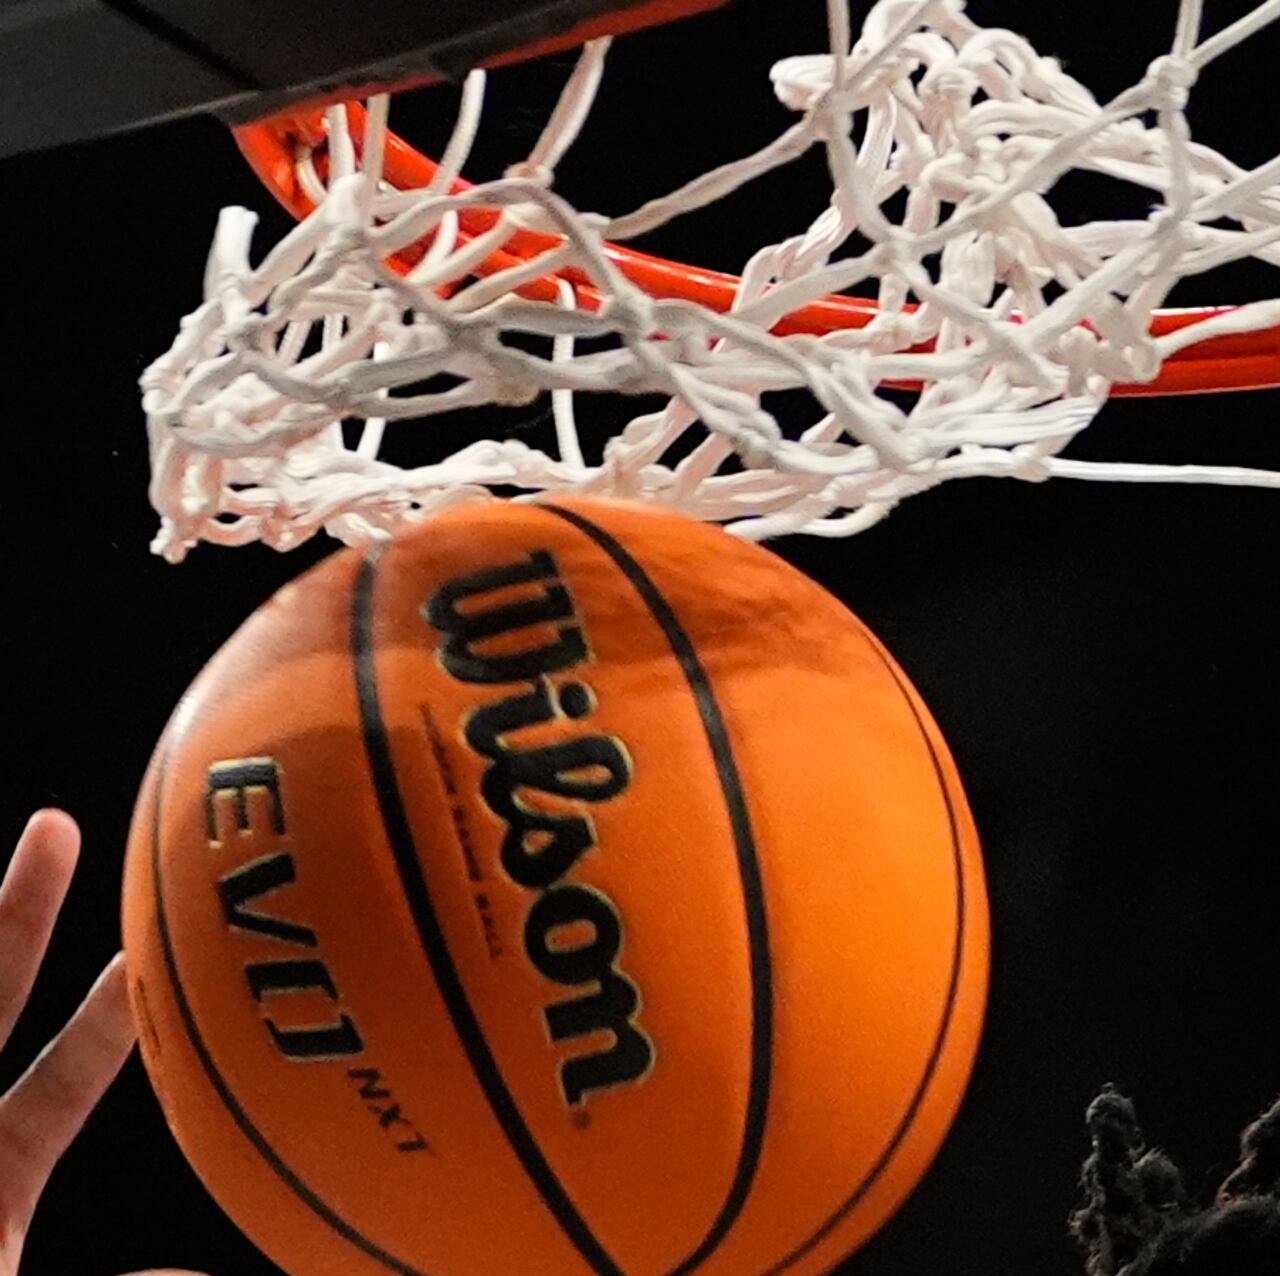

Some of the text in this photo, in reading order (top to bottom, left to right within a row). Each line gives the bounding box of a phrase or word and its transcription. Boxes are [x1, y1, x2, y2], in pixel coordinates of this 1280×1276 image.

[205, 756, 437, 1158] EVO NXT
[421, 548, 656, 1107] Wilson
